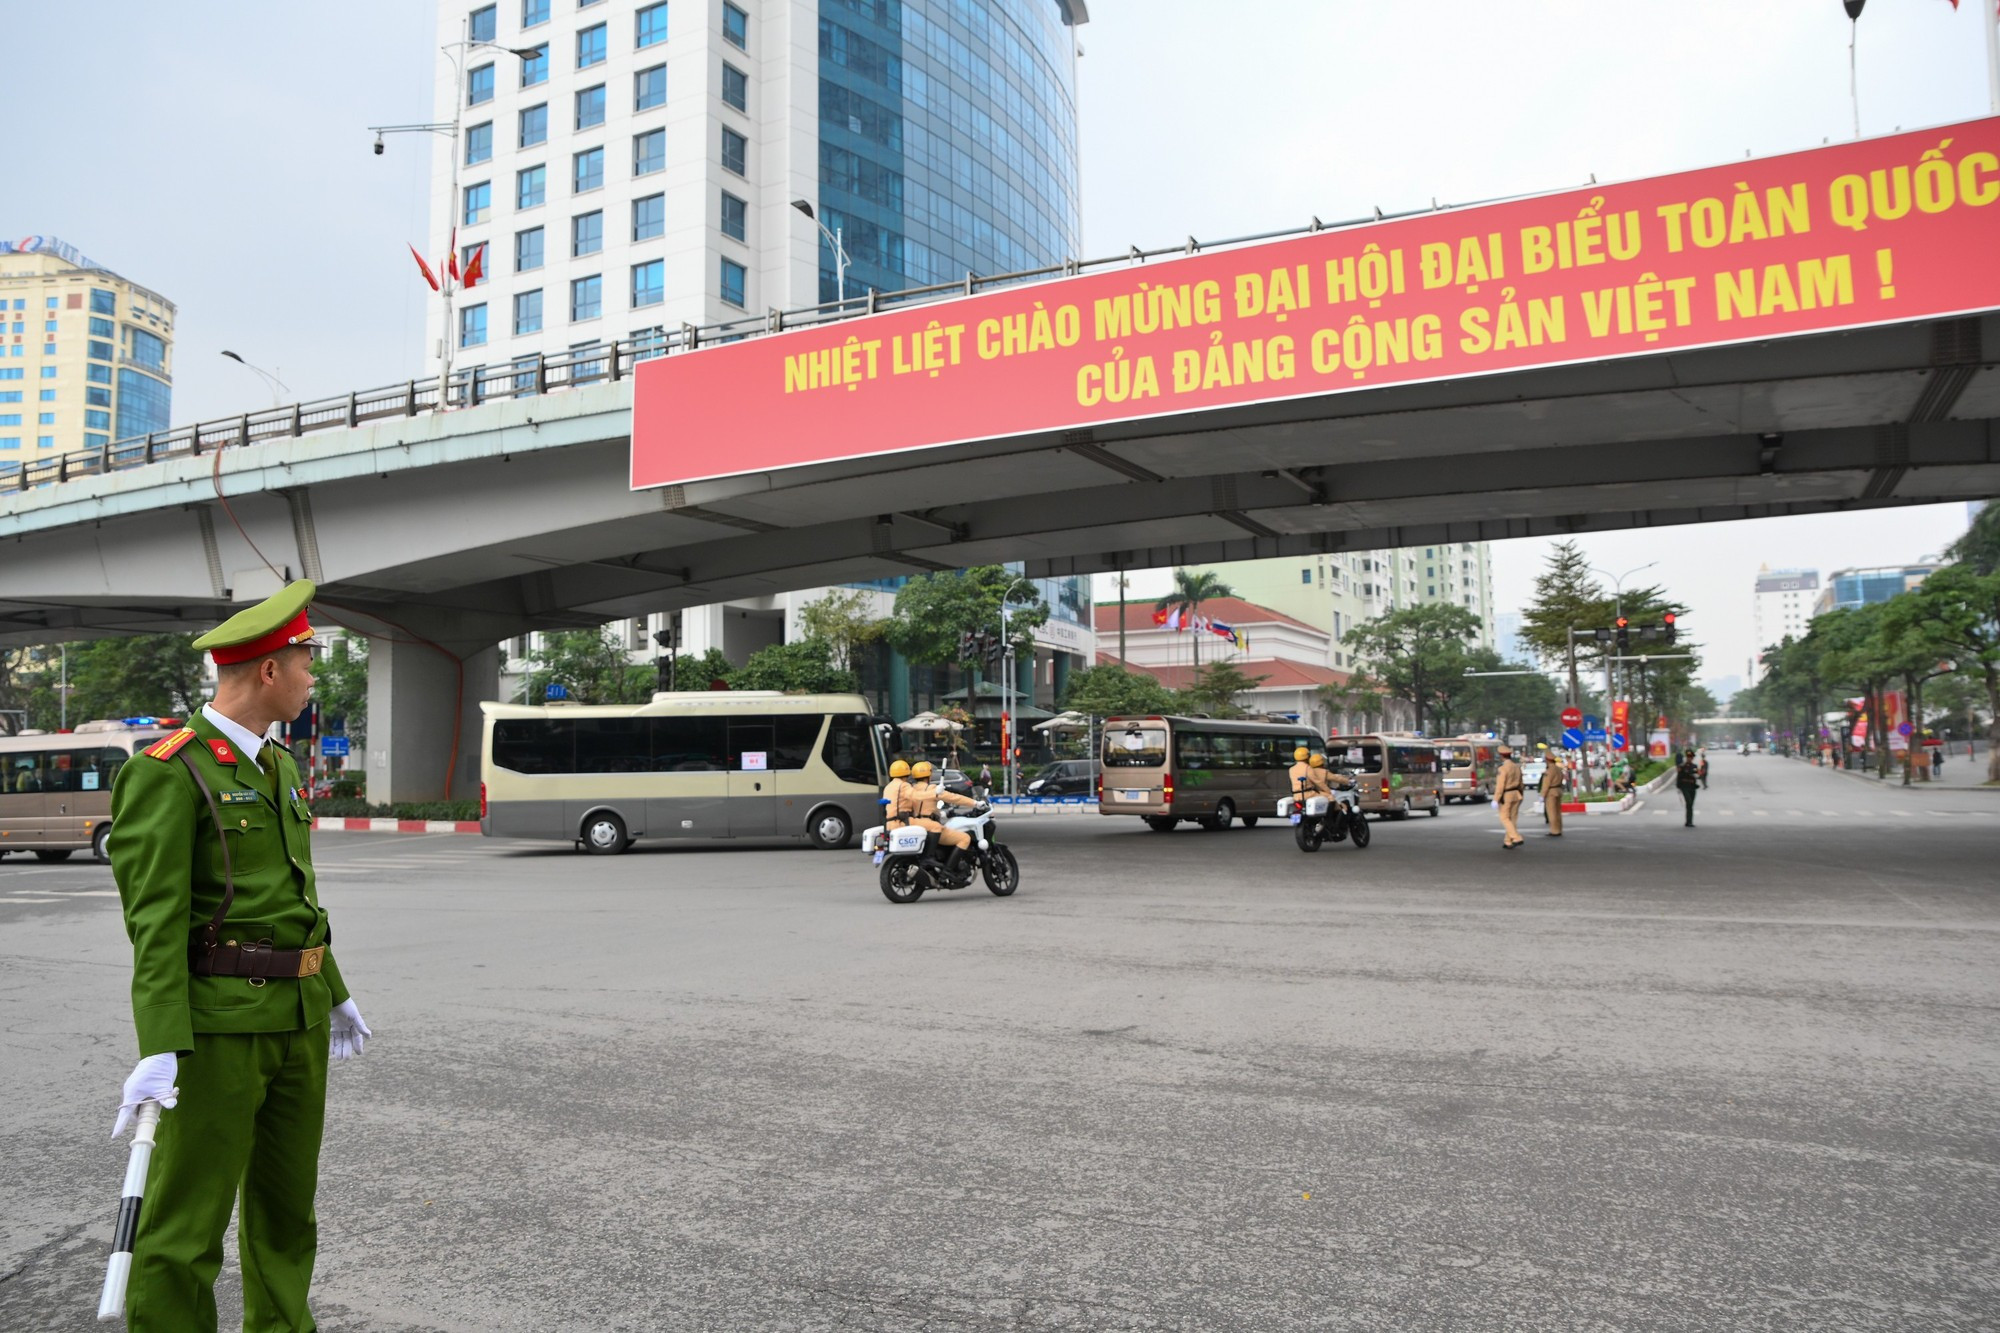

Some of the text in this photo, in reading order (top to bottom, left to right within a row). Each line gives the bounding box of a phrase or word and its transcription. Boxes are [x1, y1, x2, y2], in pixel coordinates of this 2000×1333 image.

[785, 138, 2000, 393] NHIỆT LIỆT CHÀO MỪNG ĐẠI HỘI ĐẠI BIỂU TOÀN QUỐC
[1077, 249, 1895, 406] CỦA ĐẢNG CỘNG SẢN VIỆT NAM !
[898, 837, 919, 846] CSGT
